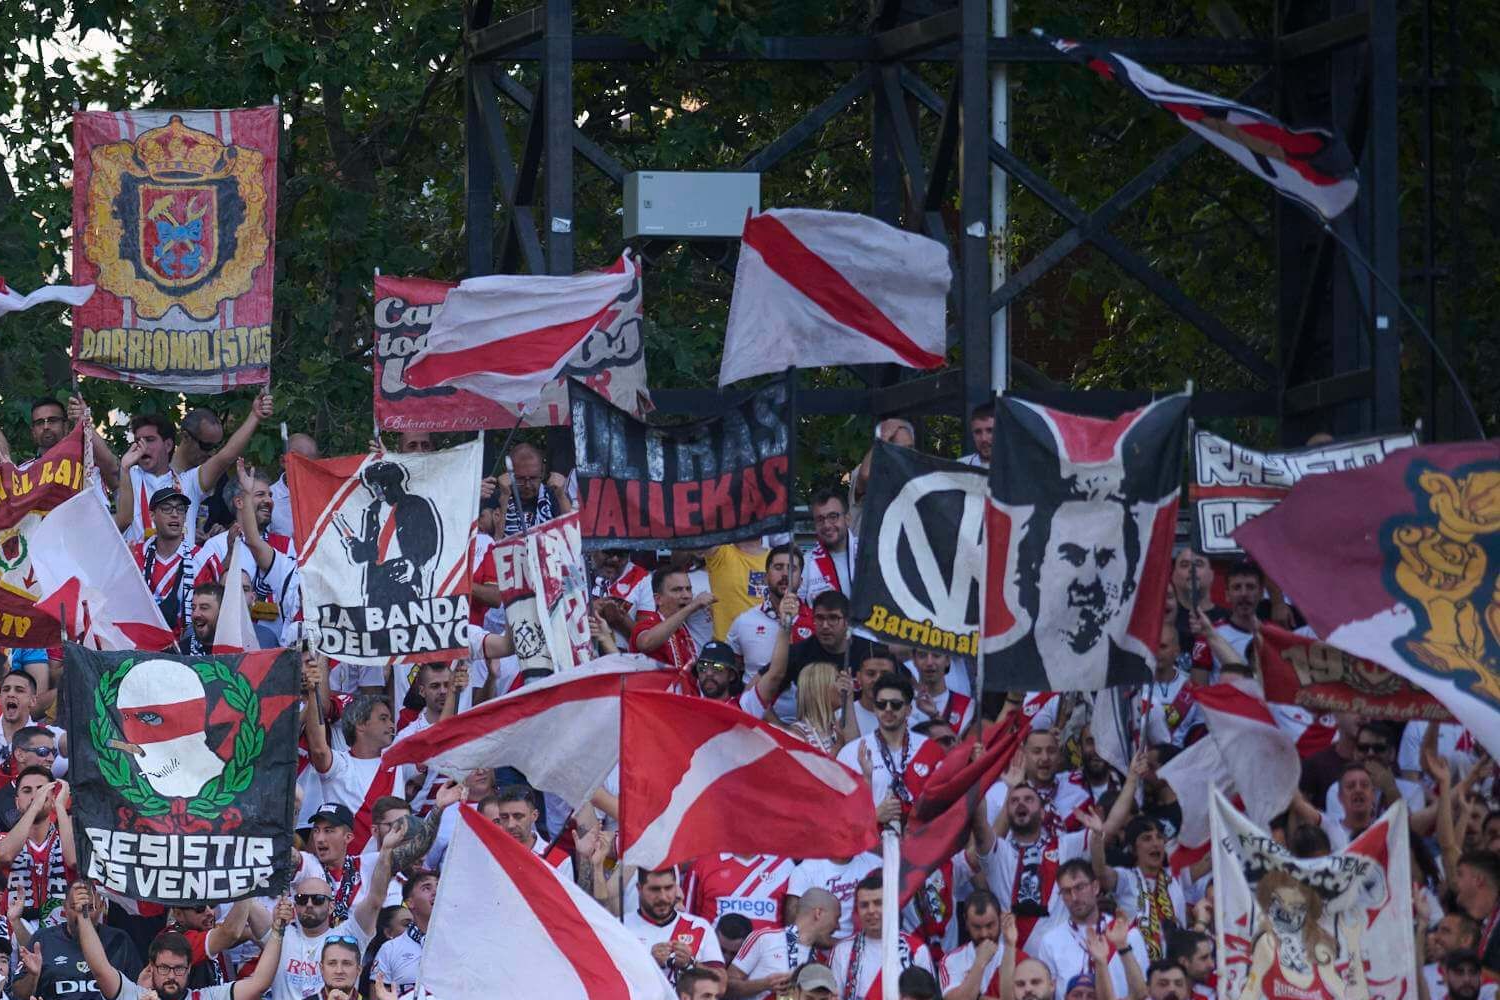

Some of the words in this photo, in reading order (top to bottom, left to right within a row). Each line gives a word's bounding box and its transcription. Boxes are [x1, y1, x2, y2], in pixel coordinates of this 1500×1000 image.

[38, 458, 83, 490] RAY
[578, 456, 789, 538] VALLEKAS
[320, 606, 357, 632] LA
[365, 595, 469, 632] BANDA
[319, 627, 380, 657] DEL
[85, 828, 275, 868] RESISTIR
[87, 851, 128, 893] ES
[134, 865, 275, 900] VENCER
[719, 899, 775, 916] priego
[286, 958, 323, 976] RAY
[55, 980, 100, 994] DIG
